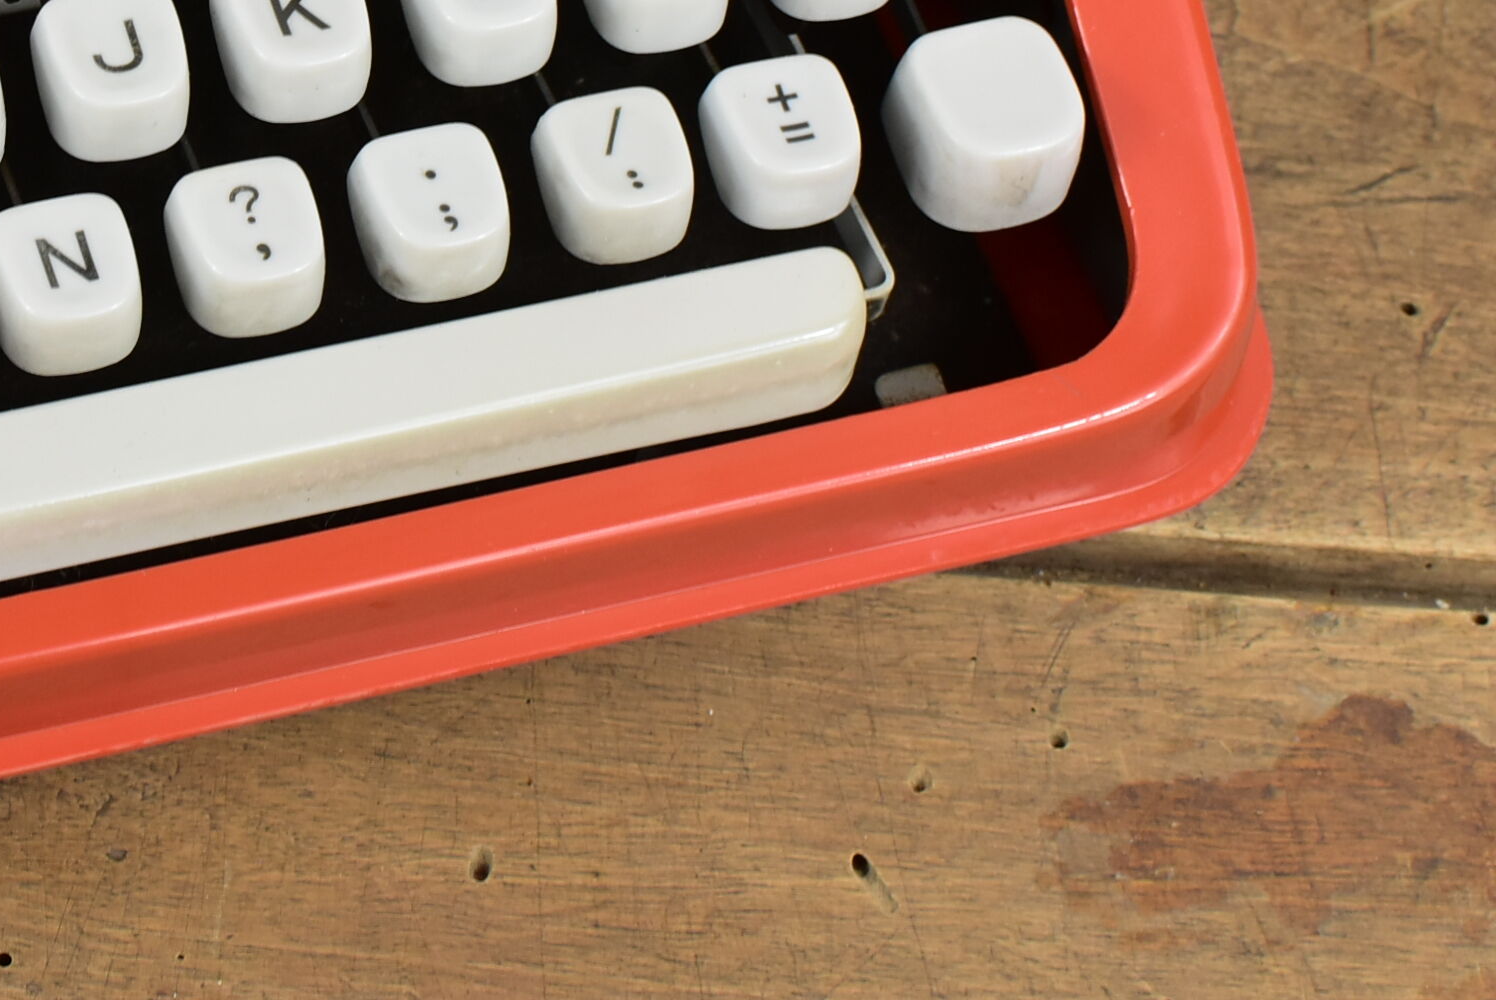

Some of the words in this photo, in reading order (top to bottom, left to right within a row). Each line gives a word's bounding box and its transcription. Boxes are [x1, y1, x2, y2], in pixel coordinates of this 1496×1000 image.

[92, 18, 144, 74] J
[766, 83, 799, 113] +
[605, 106, 622, 156] /
[779, 121, 816, 144] =
[228, 185, 260, 225] ?
[35, 229, 100, 289] N
